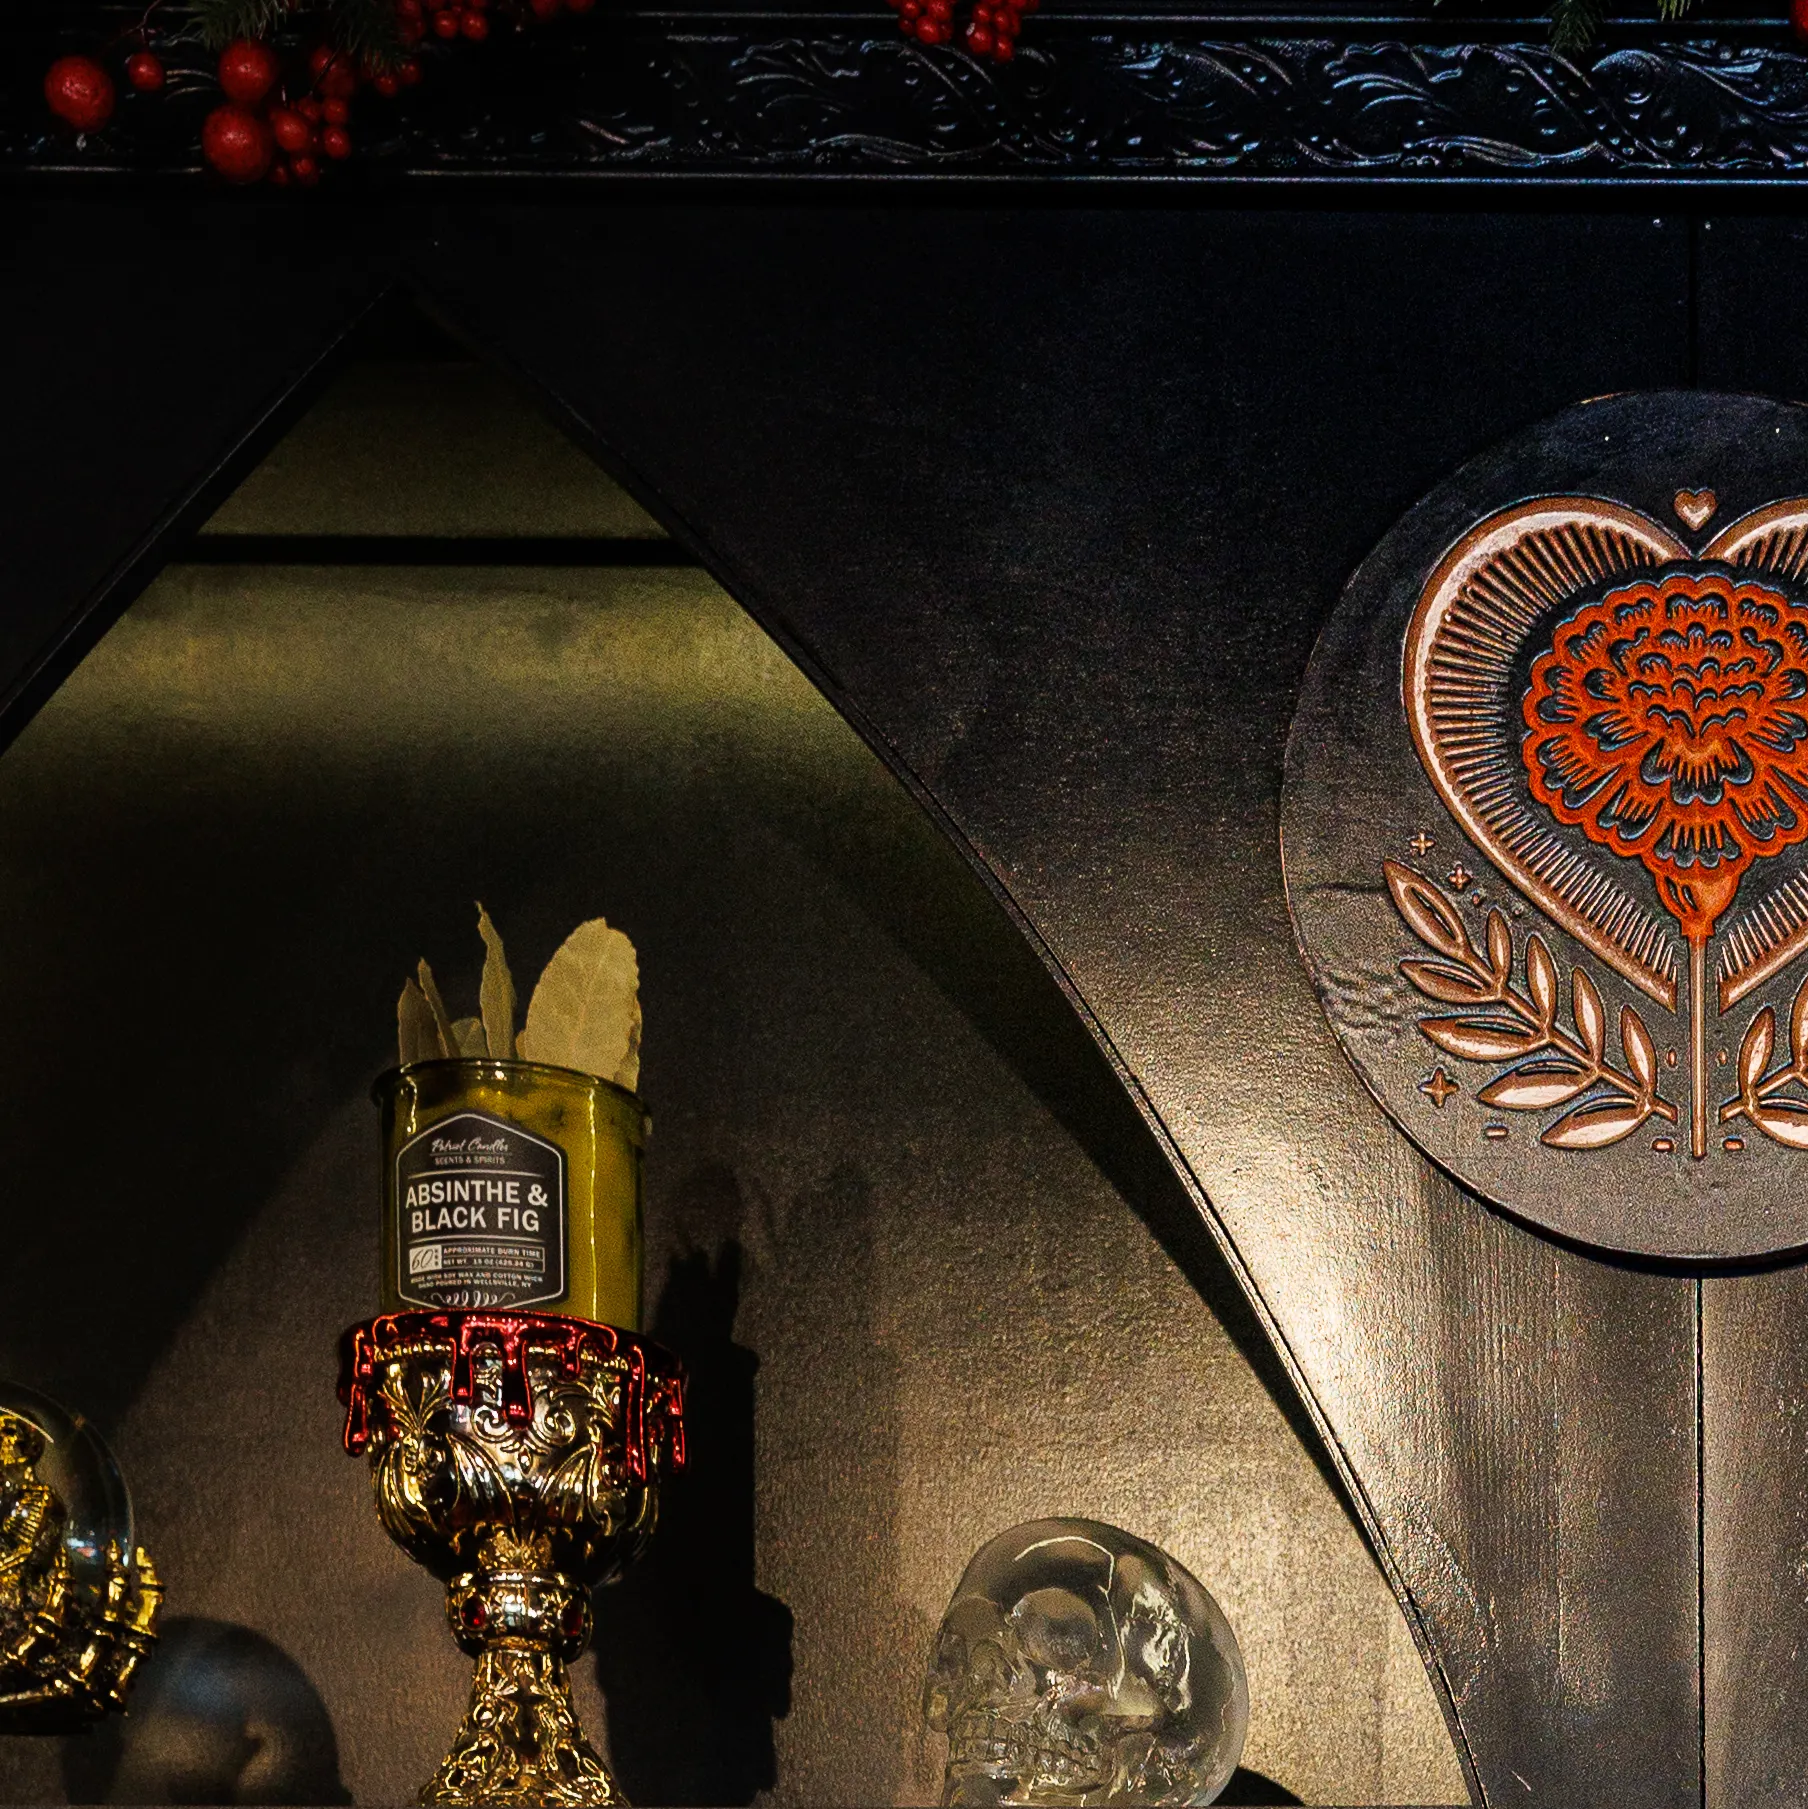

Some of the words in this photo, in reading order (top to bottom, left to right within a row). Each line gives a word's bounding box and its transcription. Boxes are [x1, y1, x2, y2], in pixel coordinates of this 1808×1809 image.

[406, 1180, 520, 1208] ABSINTHE
[527, 1184, 548, 1207] &
[412, 1207, 487, 1233] BLACK
[497, 1208, 539, 1232] FIG
